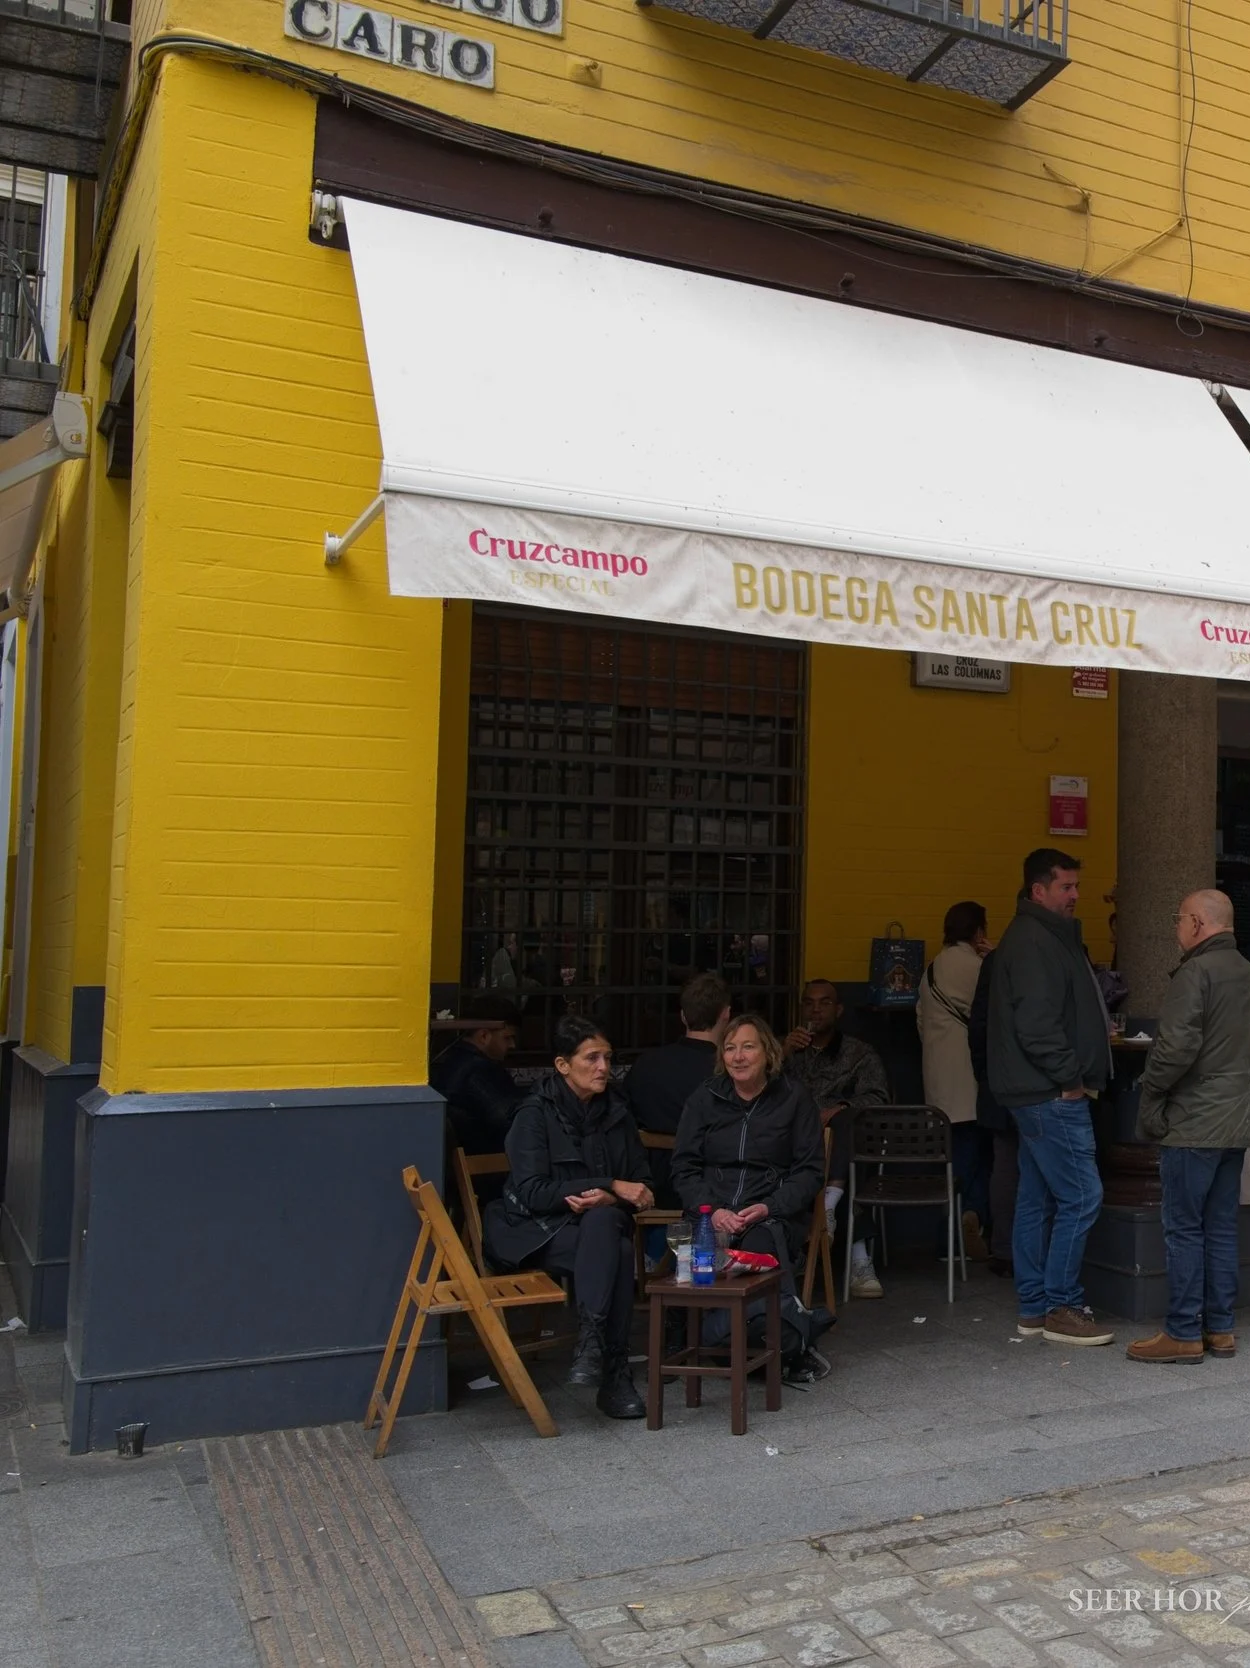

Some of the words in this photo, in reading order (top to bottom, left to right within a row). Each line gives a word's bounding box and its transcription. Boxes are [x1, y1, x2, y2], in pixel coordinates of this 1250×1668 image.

[288, 0, 491, 79] CARO
[469, 528, 648, 577] Cruzcampo
[510, 570, 615, 596] ESPECIAL
[732, 562, 899, 627] BODEGA
[914, 585, 1038, 642] SANTA
[1050, 601, 1145, 650] CRUZ
[931, 663, 949, 676] LAS
[954, 666, 1001, 680] COLUMNAS
